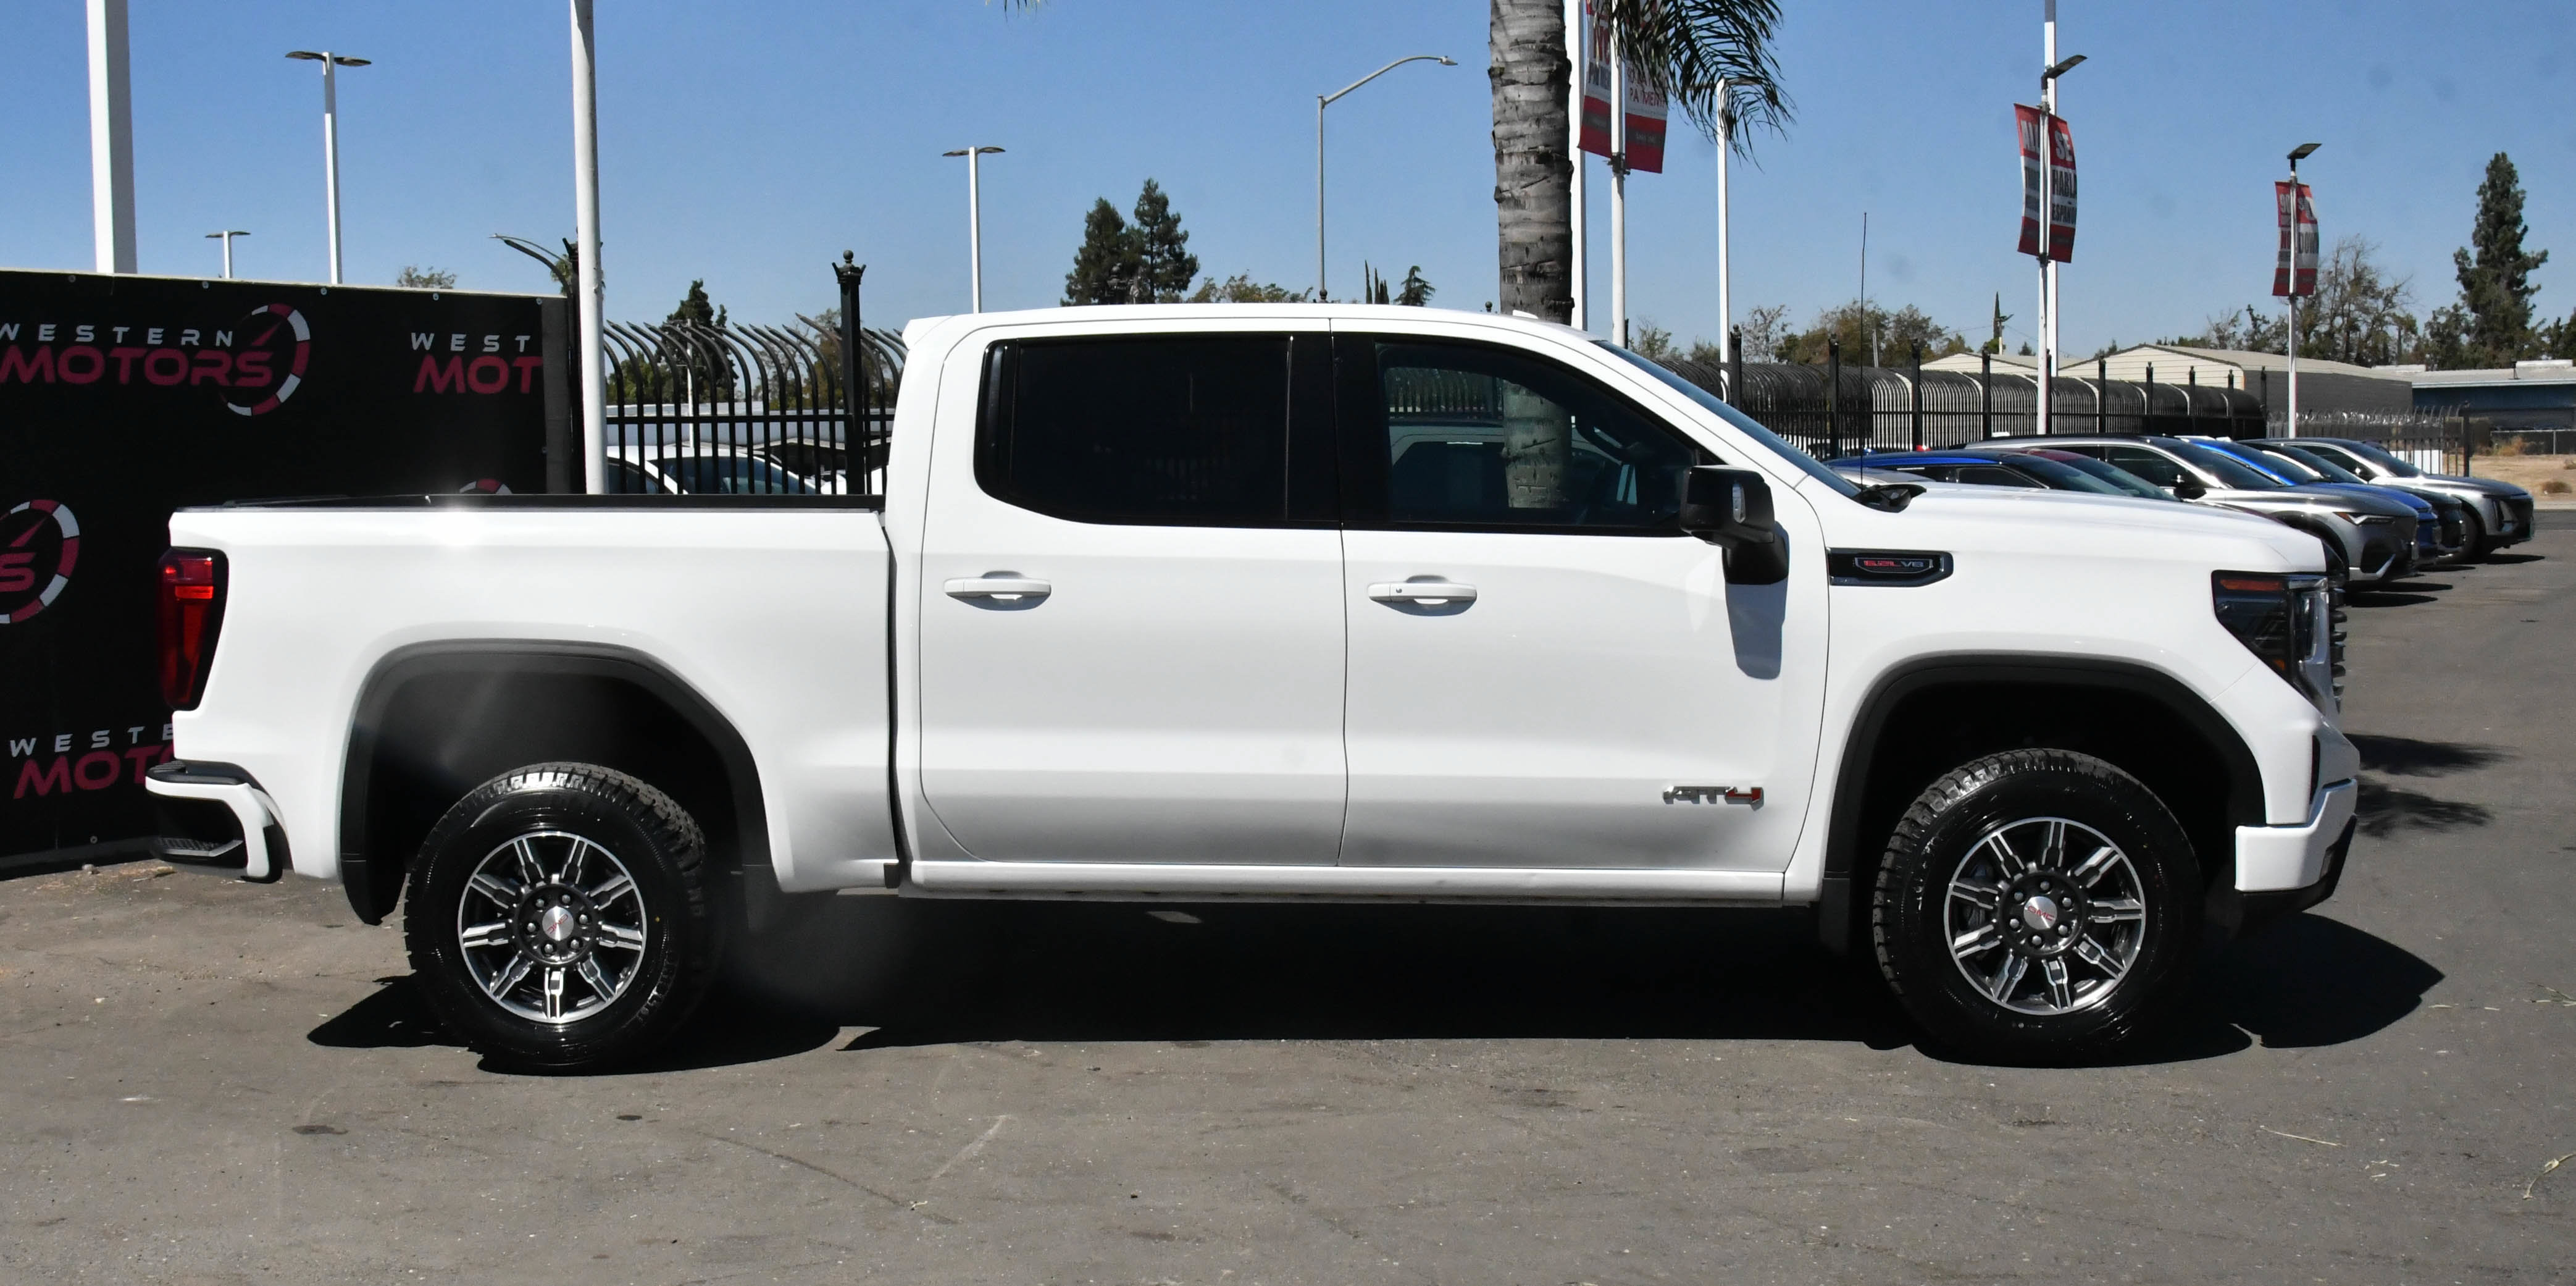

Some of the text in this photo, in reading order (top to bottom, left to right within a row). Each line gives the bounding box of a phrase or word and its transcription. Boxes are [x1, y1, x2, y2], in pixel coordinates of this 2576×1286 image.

[2054, 130, 2073, 161] SE
[0, 323, 233, 347] WESTERN
[411, 332, 531, 353] WEST
[0, 345, 274, 386] MOTORS
[414, 355, 543, 394] MOT
[1663, 786, 1764, 812] AT4
[547, 914, 569, 935] GMC
[2028, 906, 2055, 921] GMC
